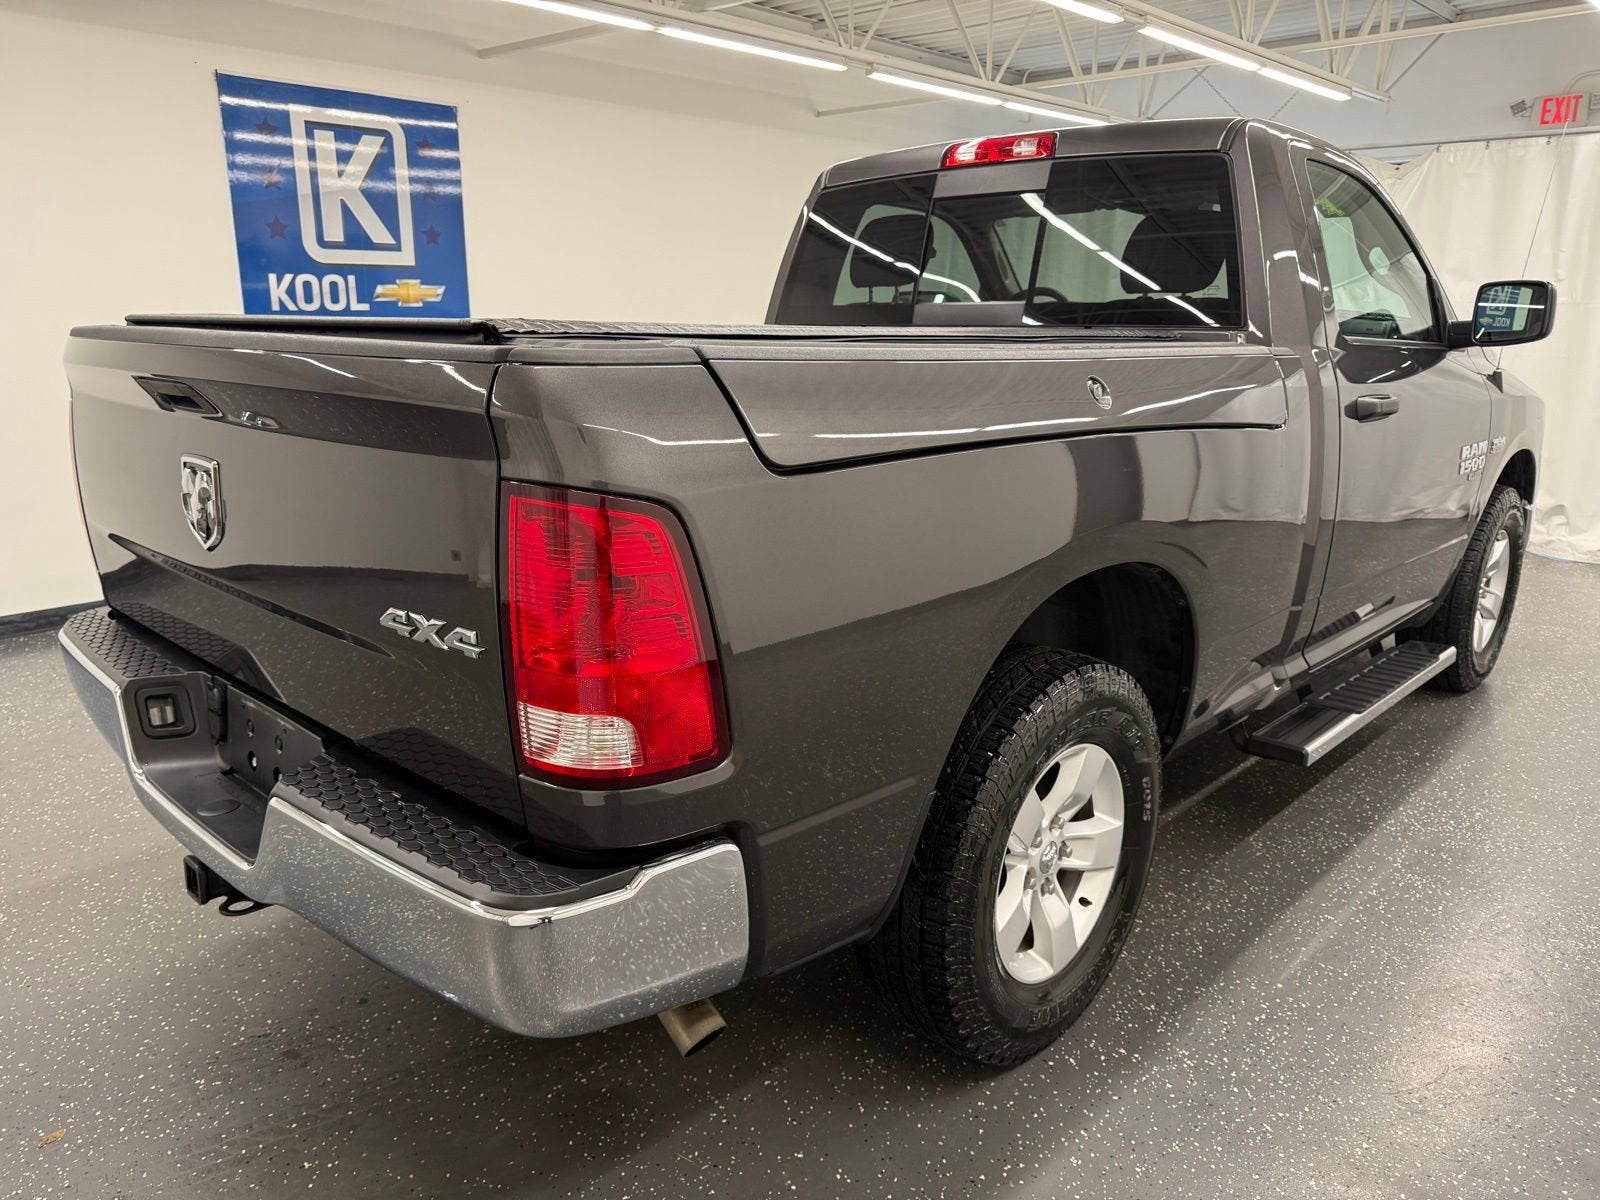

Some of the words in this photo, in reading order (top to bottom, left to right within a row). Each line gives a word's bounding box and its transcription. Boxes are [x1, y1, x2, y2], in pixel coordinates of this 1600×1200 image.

[1540, 94, 1584, 125] EXIT
[313, 129, 397, 244] K
[268, 272, 370, 312] KOOL
[1459, 455, 1486, 476] 1500
[1461, 440, 1489, 461] RAM
